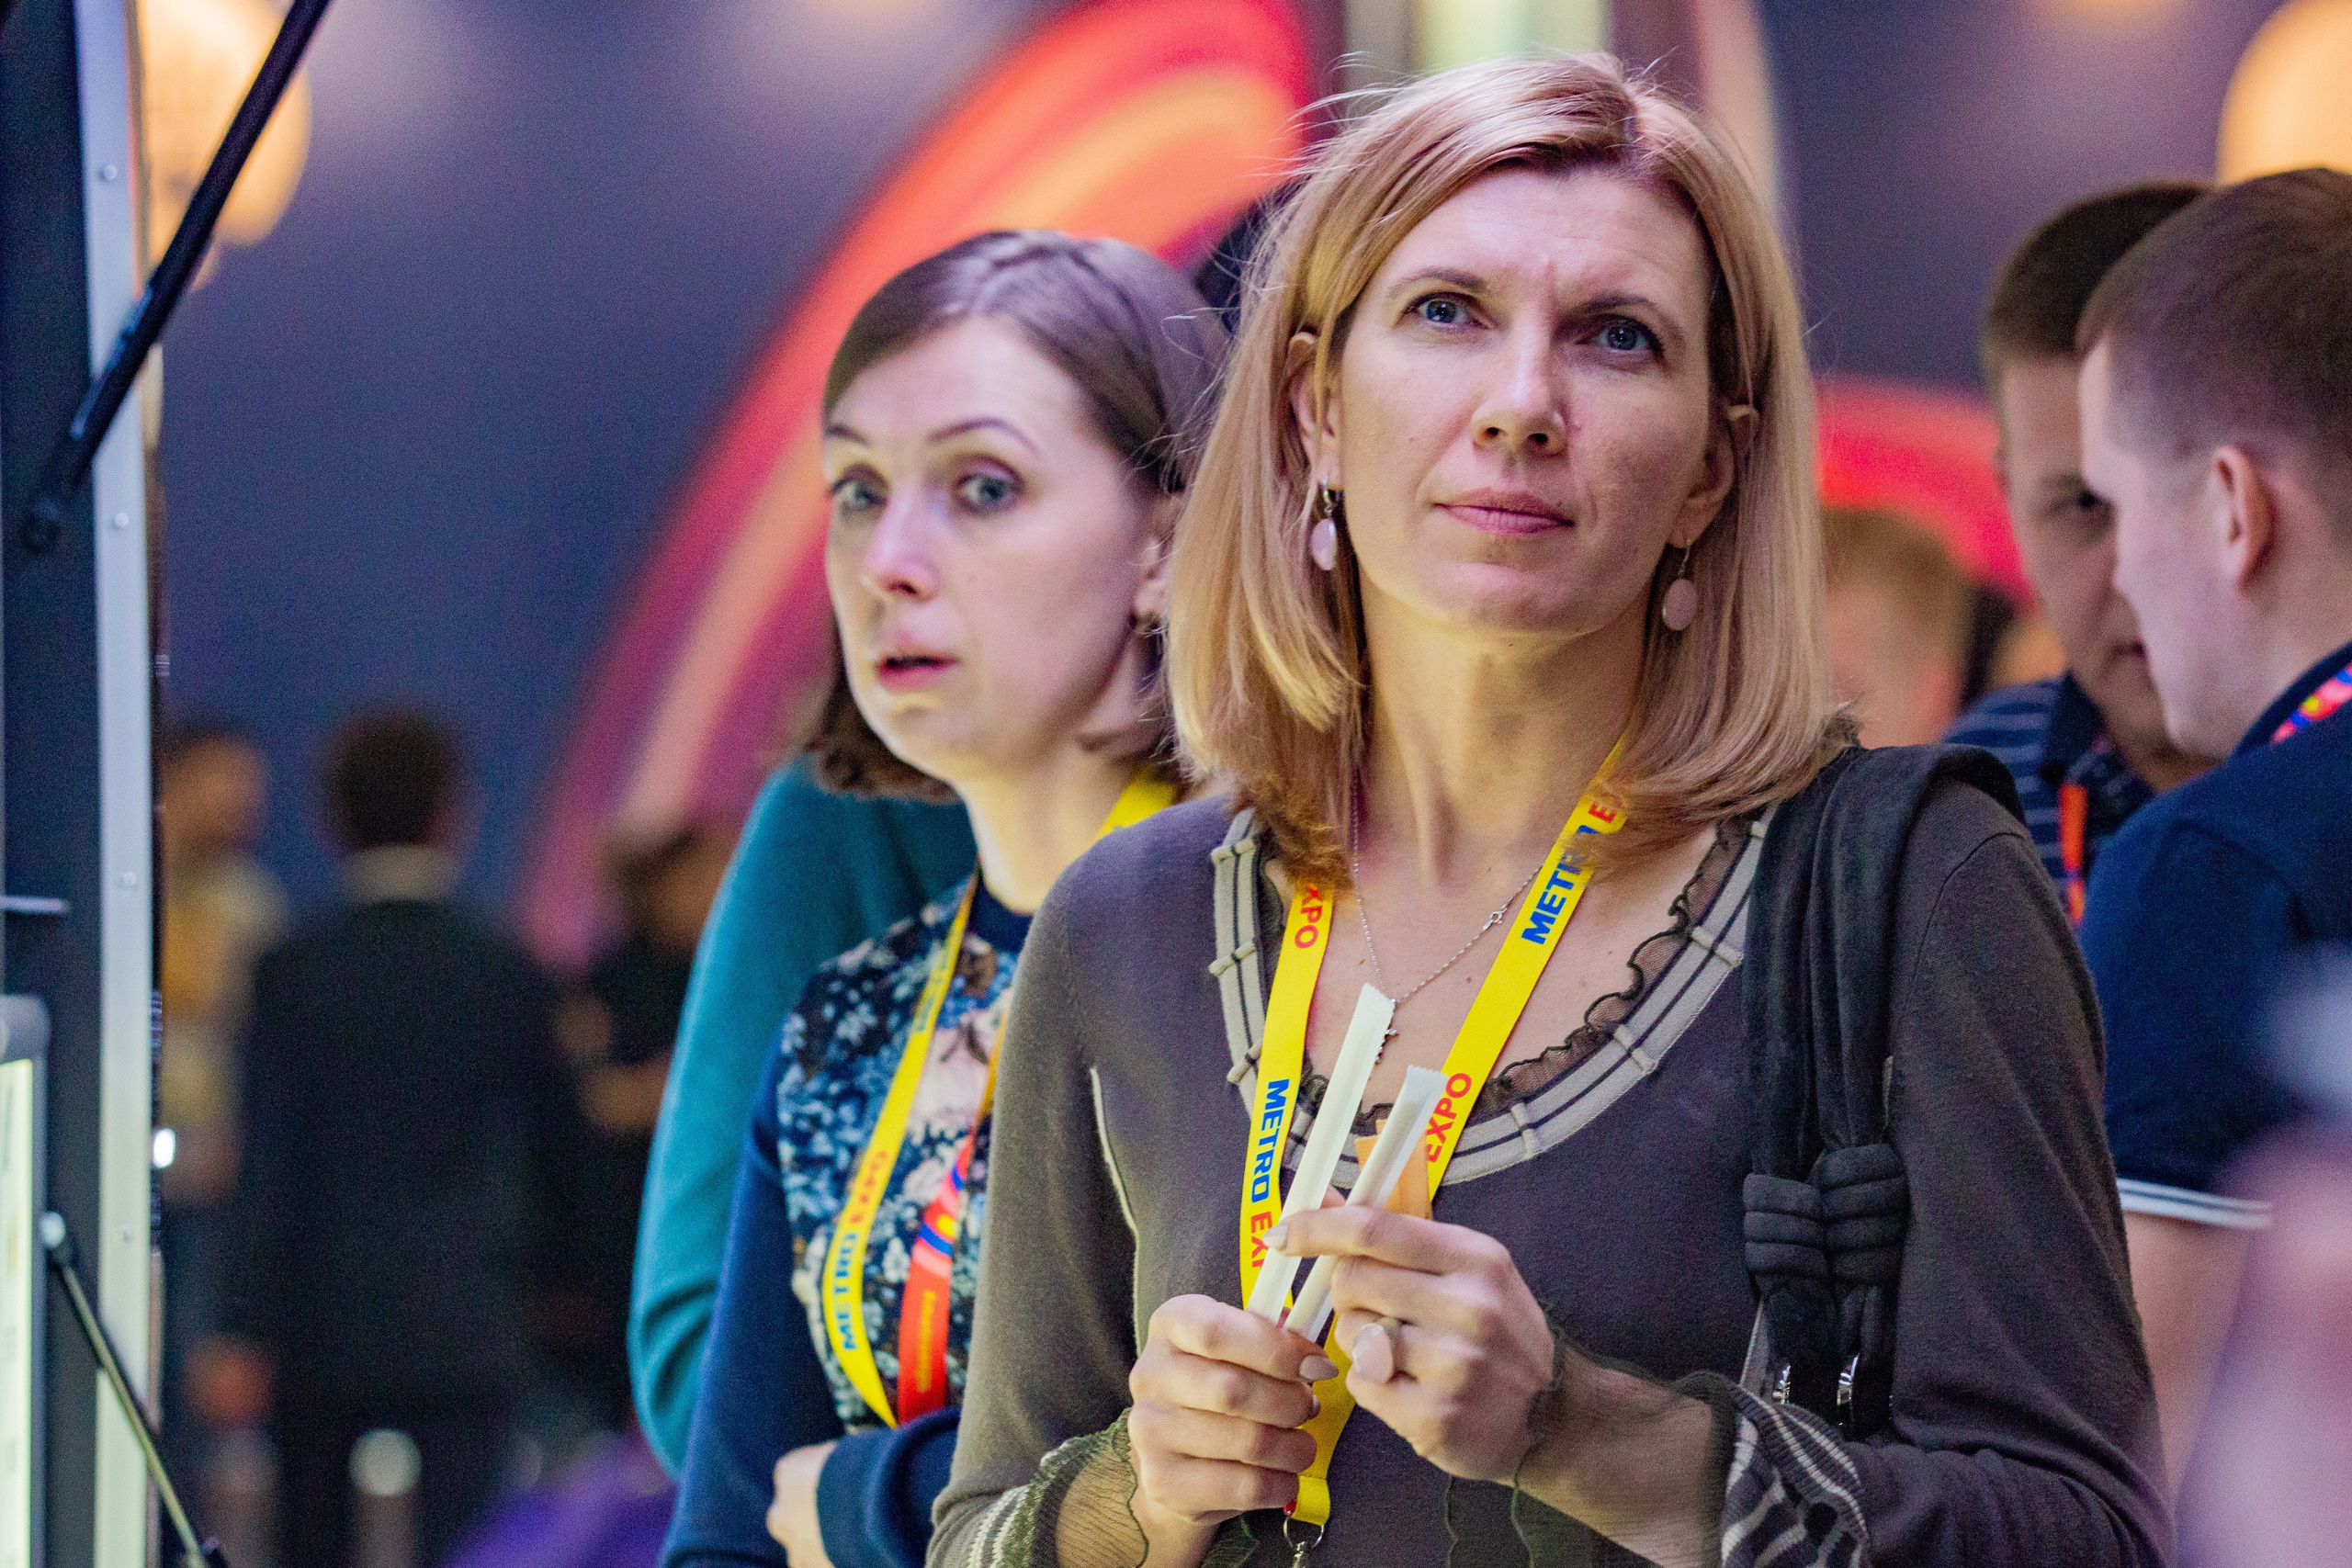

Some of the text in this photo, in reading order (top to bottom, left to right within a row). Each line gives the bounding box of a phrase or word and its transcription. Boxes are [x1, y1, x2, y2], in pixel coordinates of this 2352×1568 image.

[1294, 883, 1324, 950] XPO
[1250, 1077, 1290, 1203] METRO
[1426, 1072, 1472, 1164] EXPO
